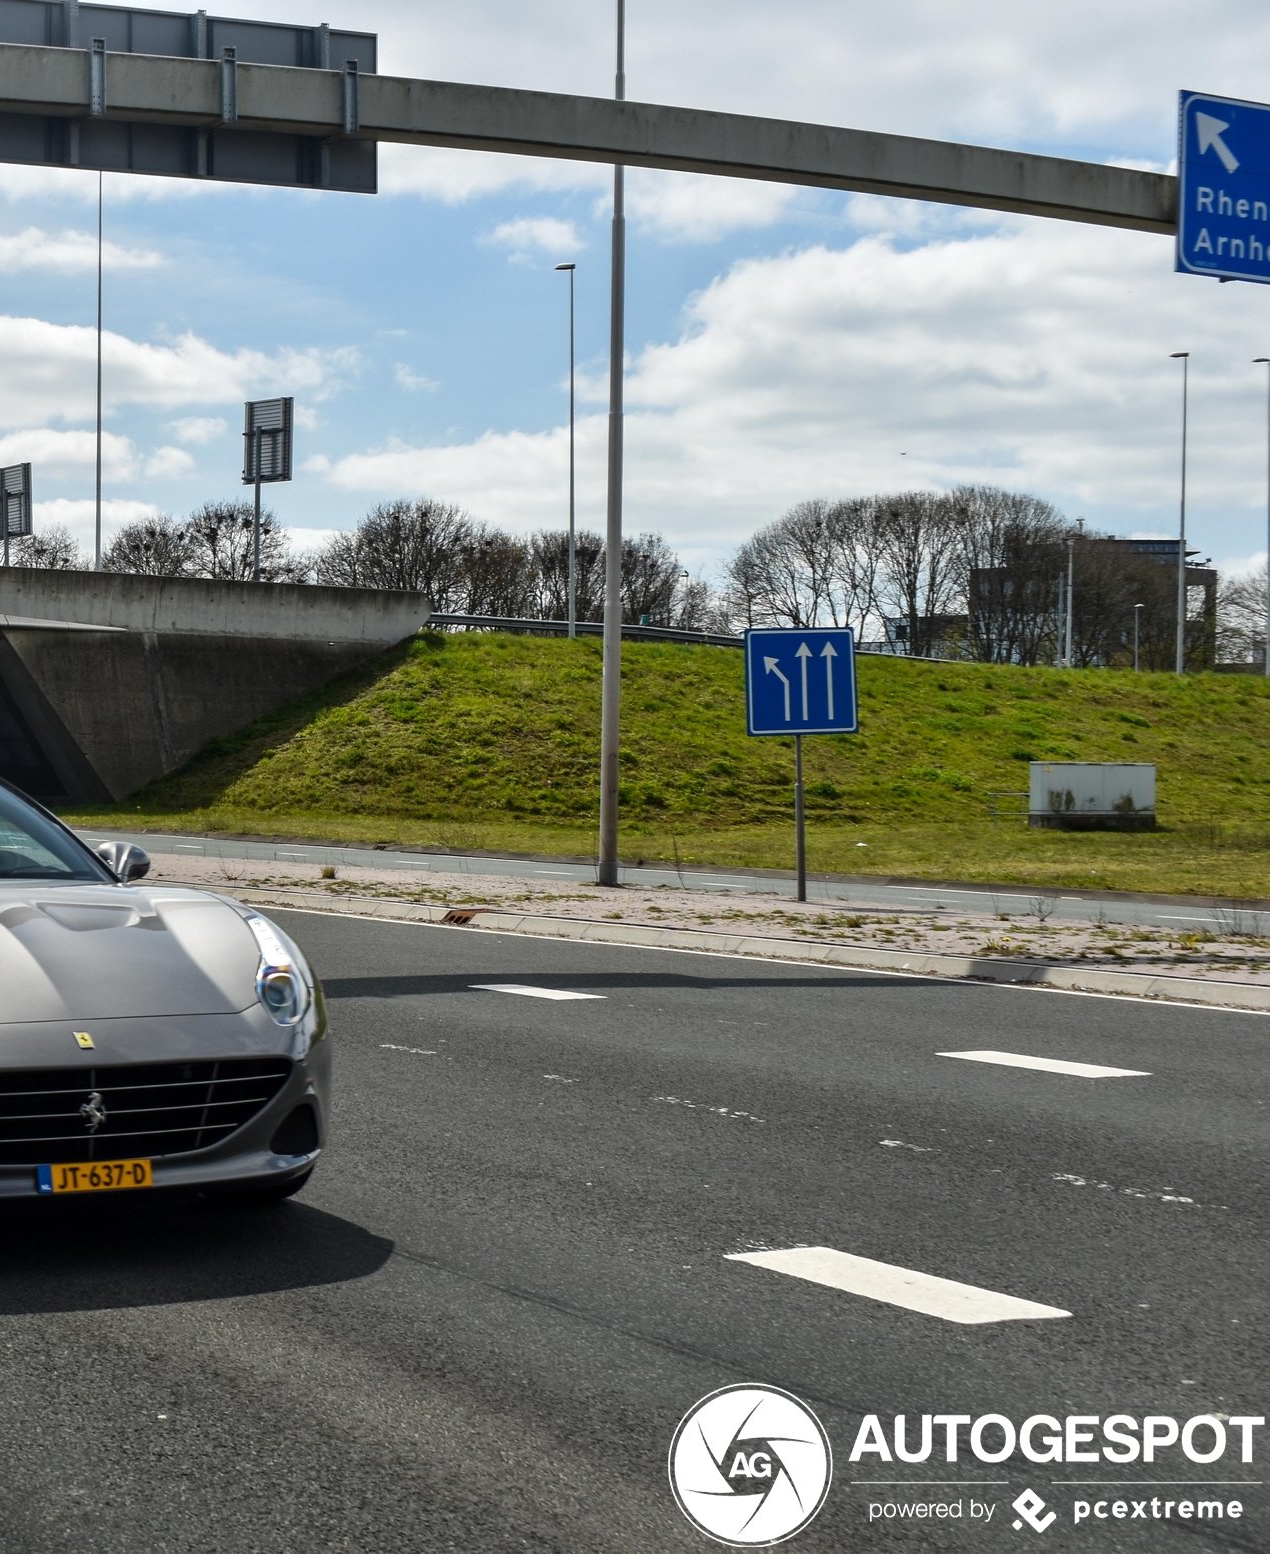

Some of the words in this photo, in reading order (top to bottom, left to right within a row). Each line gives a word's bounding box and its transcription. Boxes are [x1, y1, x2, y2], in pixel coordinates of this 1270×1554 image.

[1197, 186, 1267, 221] Rhen
[1193, 227, 1270, 262] Arnh
[58, 1163, 146, 1190] JT-637-D
